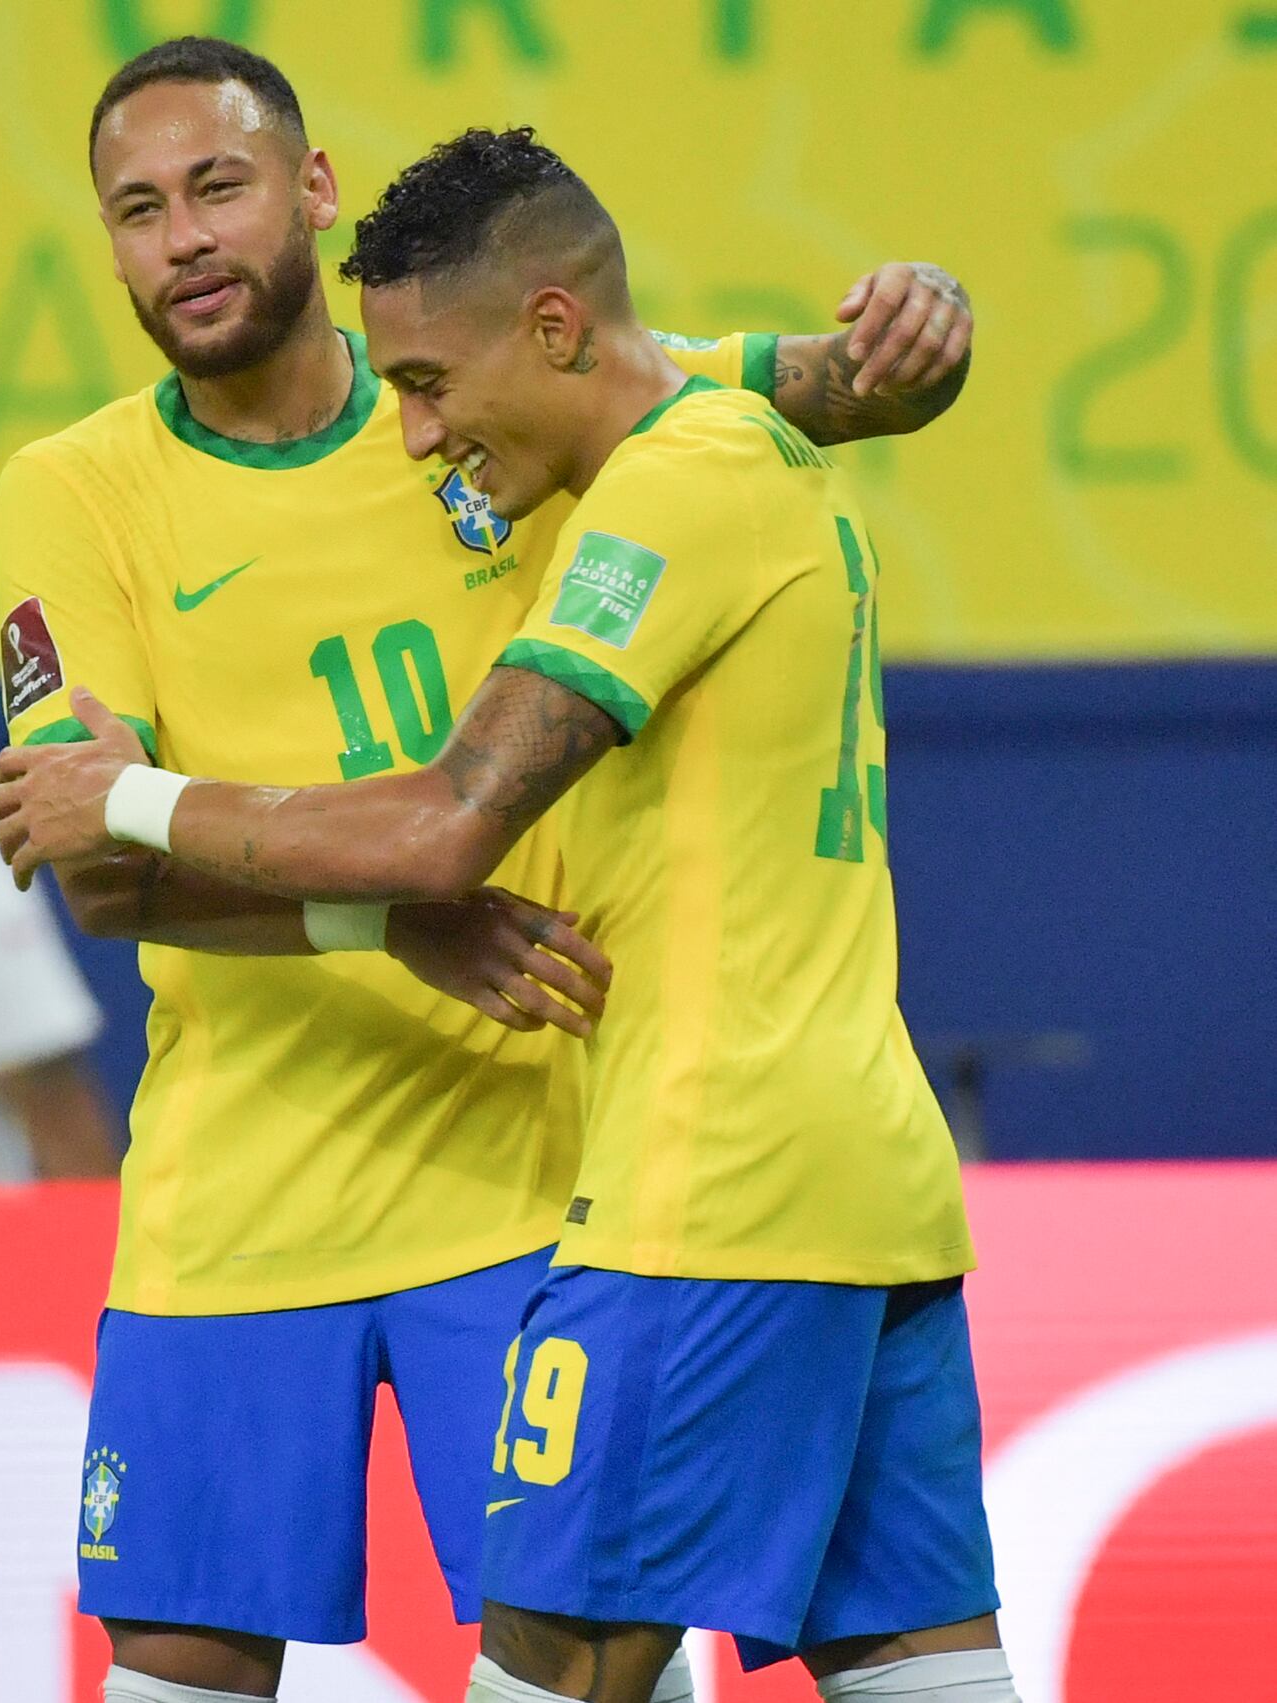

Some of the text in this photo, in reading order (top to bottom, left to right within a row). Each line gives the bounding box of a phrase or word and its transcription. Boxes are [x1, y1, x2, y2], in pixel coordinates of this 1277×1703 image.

[465, 497, 489, 514] CBF
[464, 555, 519, 591] BRASIL
[571, 565, 641, 601] FOOTBALL
[577, 556, 648, 591] LIVING
[599, 596, 633, 621] FIFA
[308, 618, 455, 782] 10
